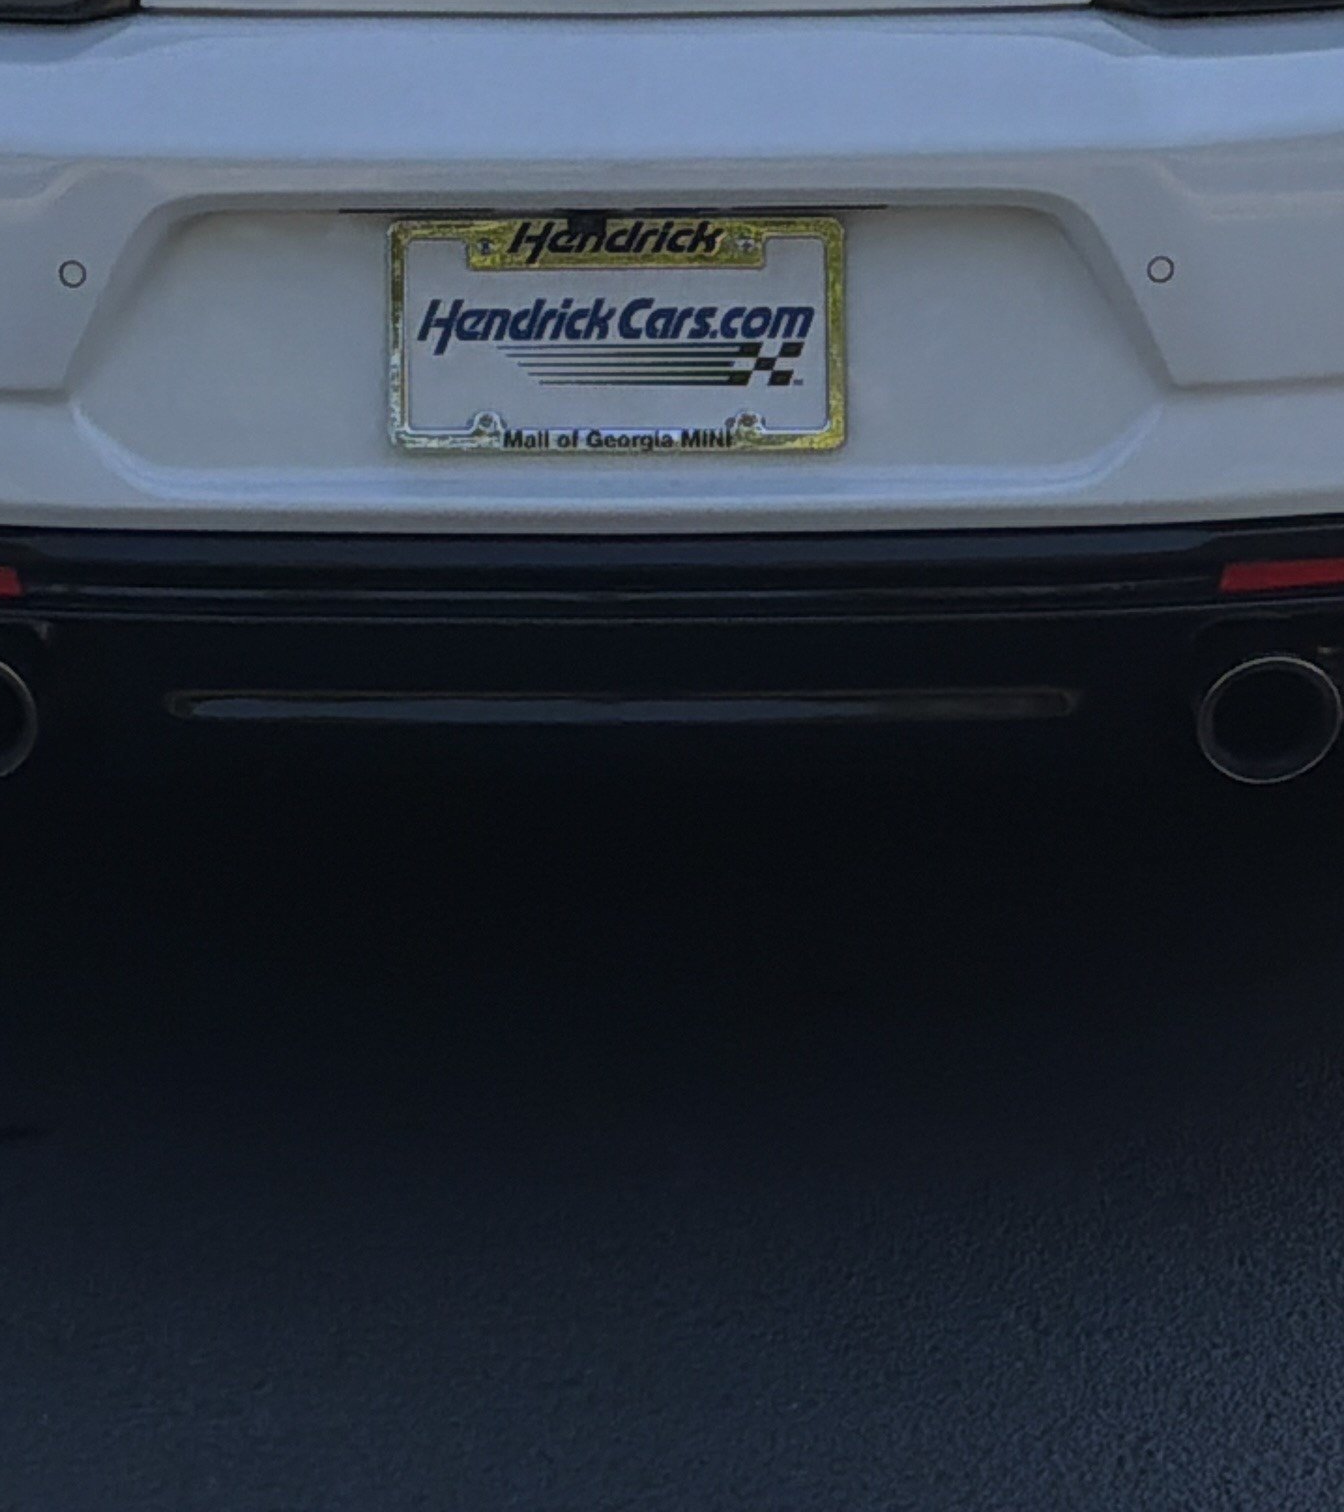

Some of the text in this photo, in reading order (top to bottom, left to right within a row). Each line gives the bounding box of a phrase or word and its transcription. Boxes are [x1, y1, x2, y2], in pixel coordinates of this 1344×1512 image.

[506, 221, 725, 264] Hendrick
[503, 429, 734, 452] Mall of Georgia MINI
